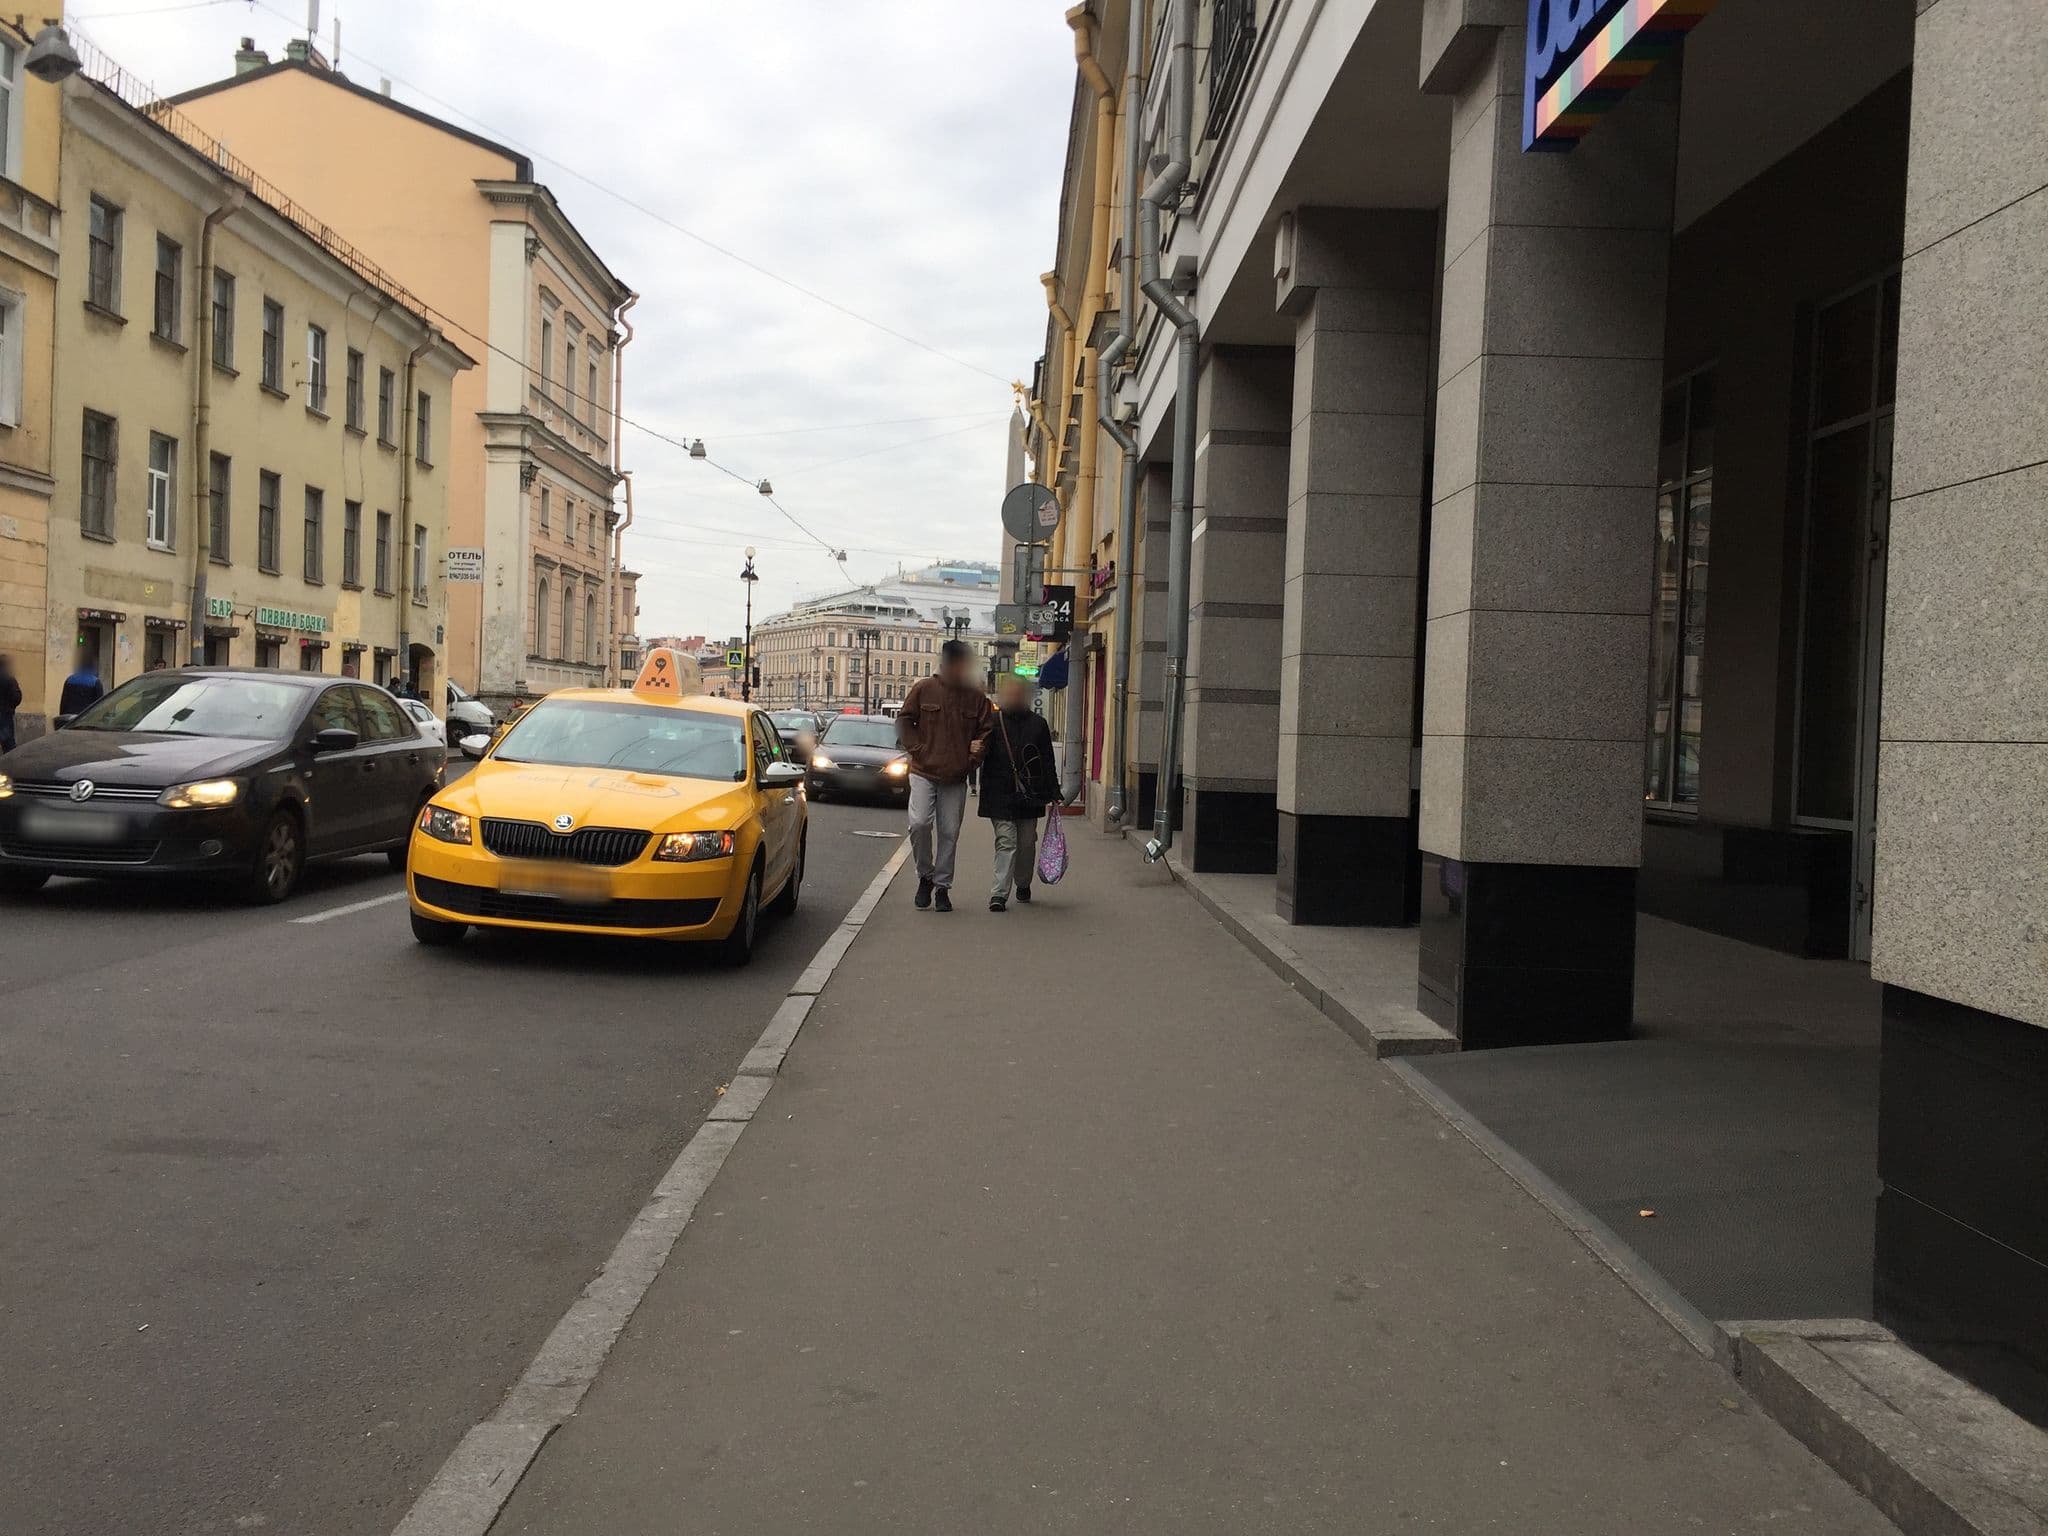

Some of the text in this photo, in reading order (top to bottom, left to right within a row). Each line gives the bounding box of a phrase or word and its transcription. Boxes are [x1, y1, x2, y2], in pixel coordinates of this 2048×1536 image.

[448, 551, 482, 560] ОТЕЛЬ
[211, 598, 232, 617] БАР
[260, 608, 327, 632] ПИВНАЯ БОЧКА
